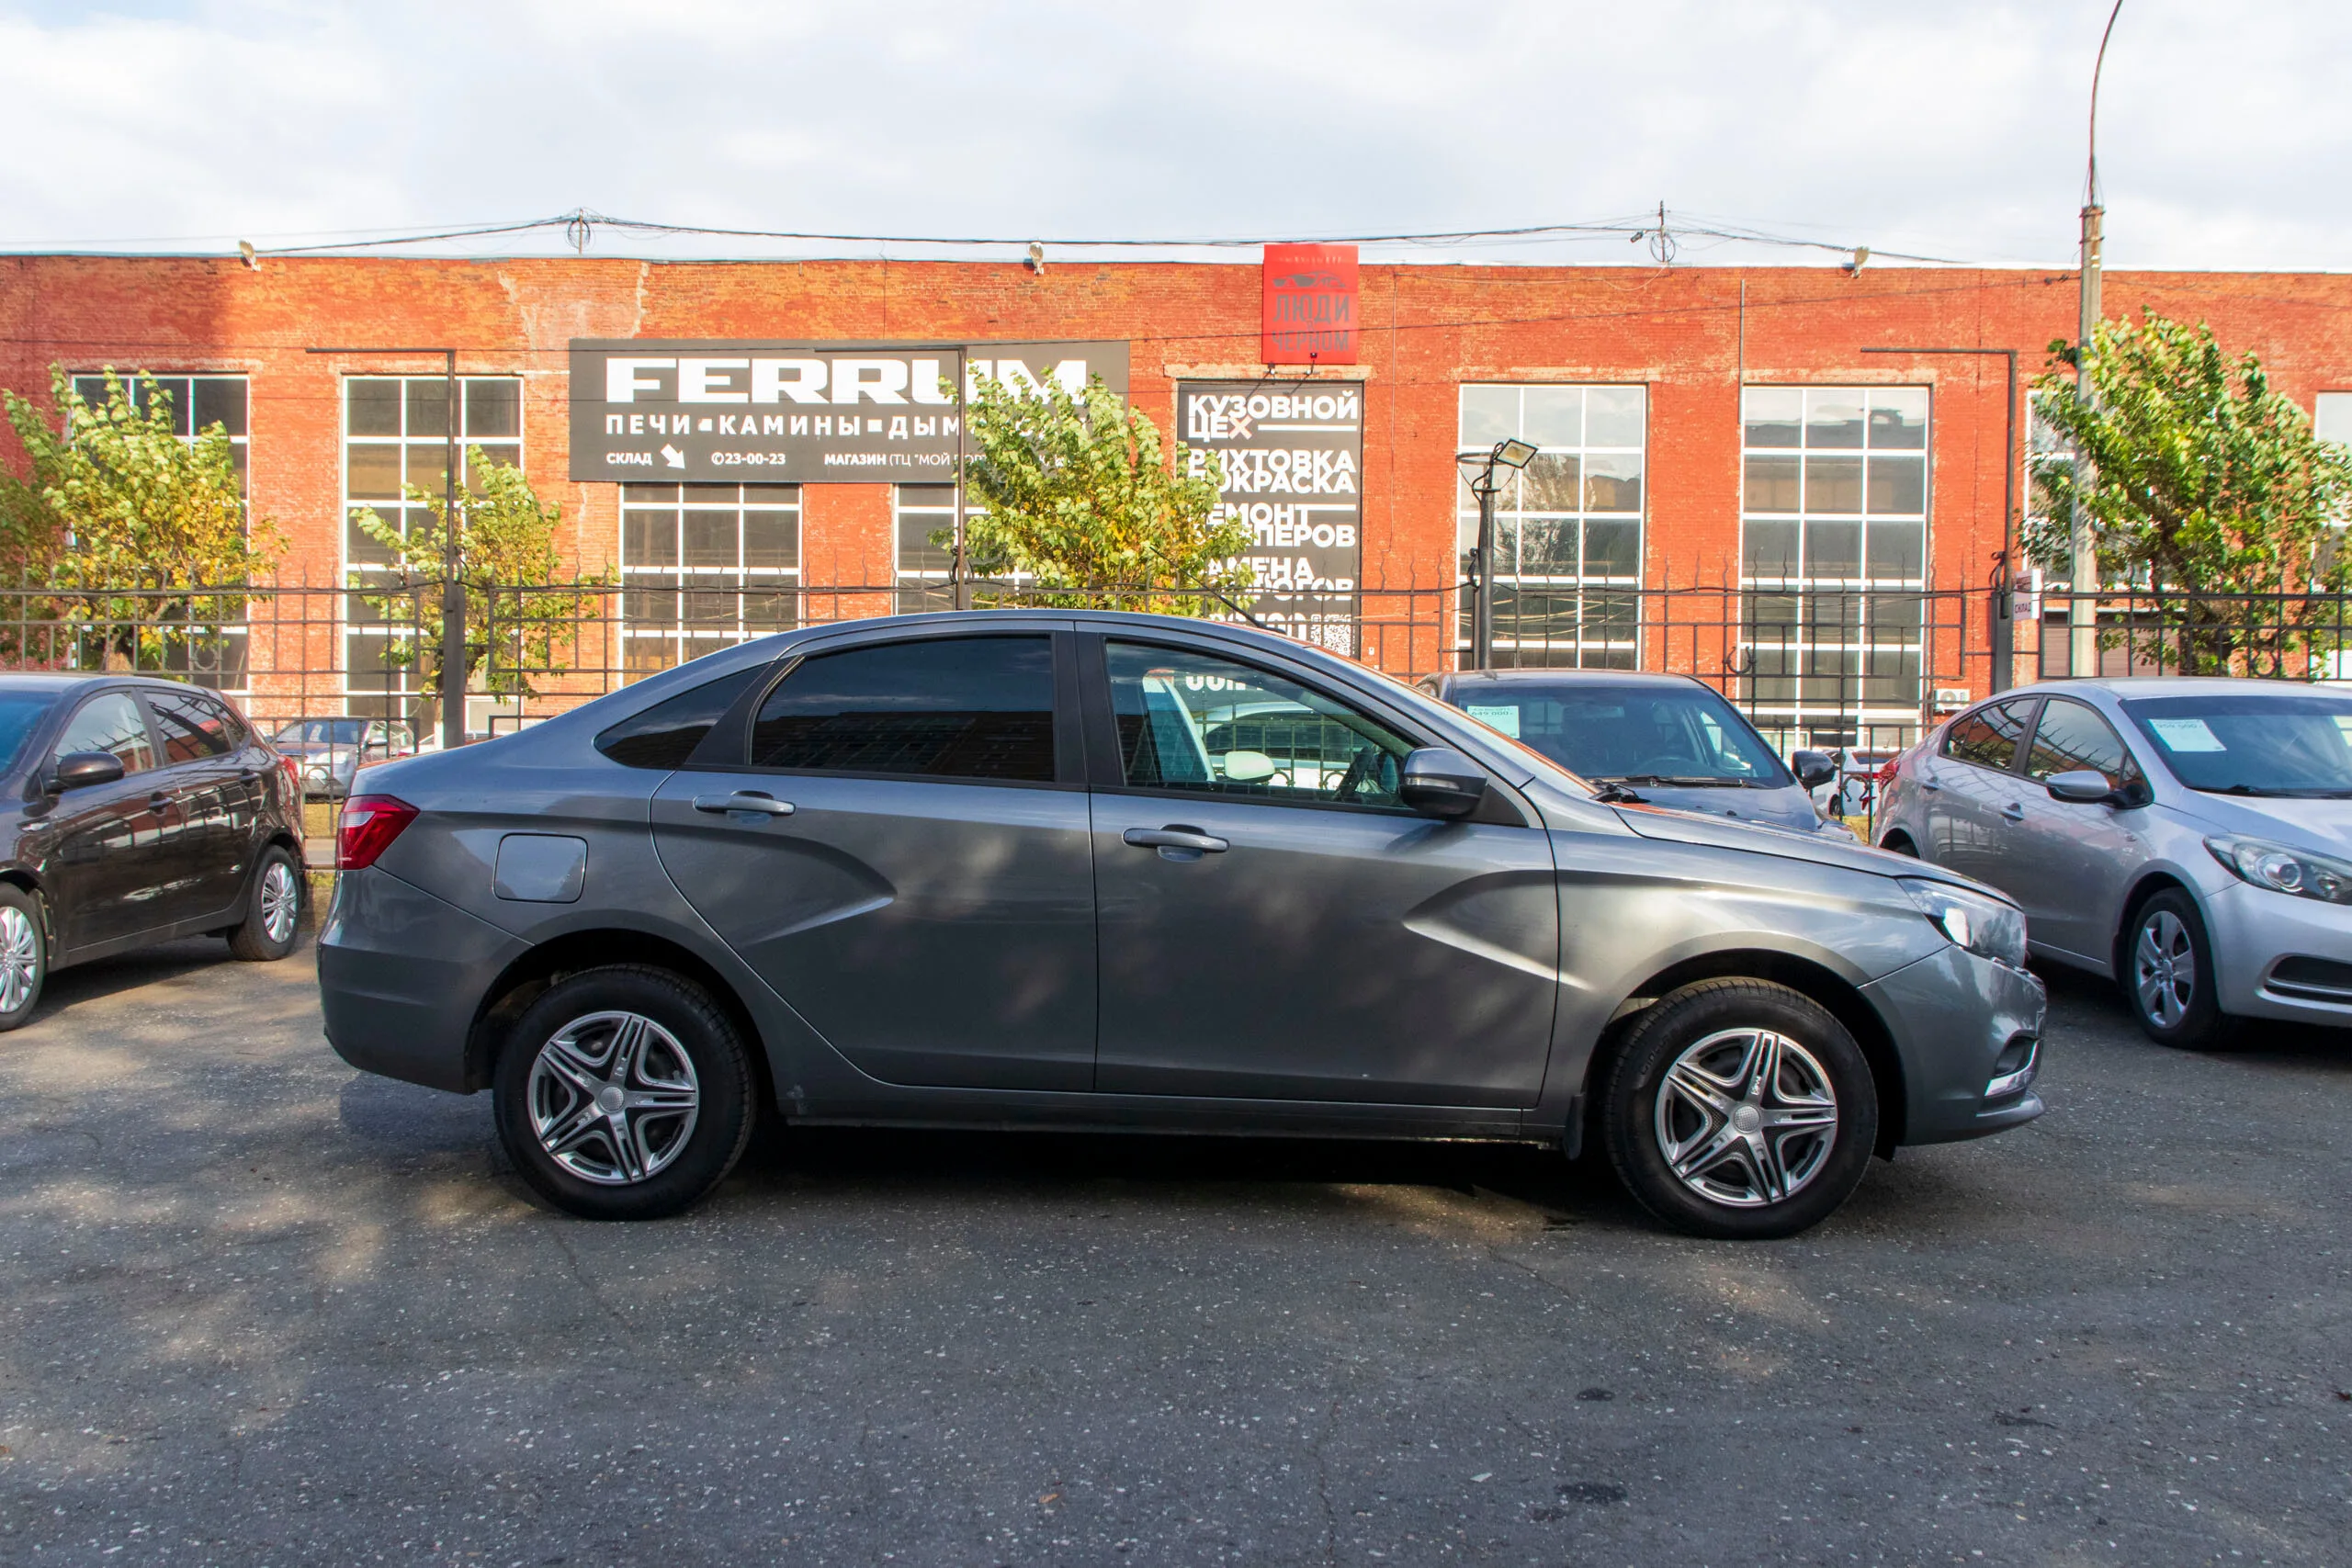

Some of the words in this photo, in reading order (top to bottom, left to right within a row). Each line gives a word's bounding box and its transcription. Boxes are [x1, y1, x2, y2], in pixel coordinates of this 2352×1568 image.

[1272, 295, 1349, 324] ЛЮДИ
[1272, 330, 1349, 351] ЧЕРНОМ
[605, 357, 1087, 405] FERRUM
[1188, 389, 1358, 419] КУЗОВНОЙ
[605, 414, 691, 434] ПЕЧИ
[719, 415, 861, 436] КАМИНЫ
[1188, 414, 1253, 443] ЦЕХ
[606, 452, 653, 466] СКЛАД
[824, 454, 887, 466] МАГАЗИН
[888, 454, 911, 467] (ТЦ
[1188, 502, 1314, 526] ЕМОНТ
[1188, 524, 1356, 548] ПЕРОВ
[1188, 556, 1315, 580] АМЕНА
